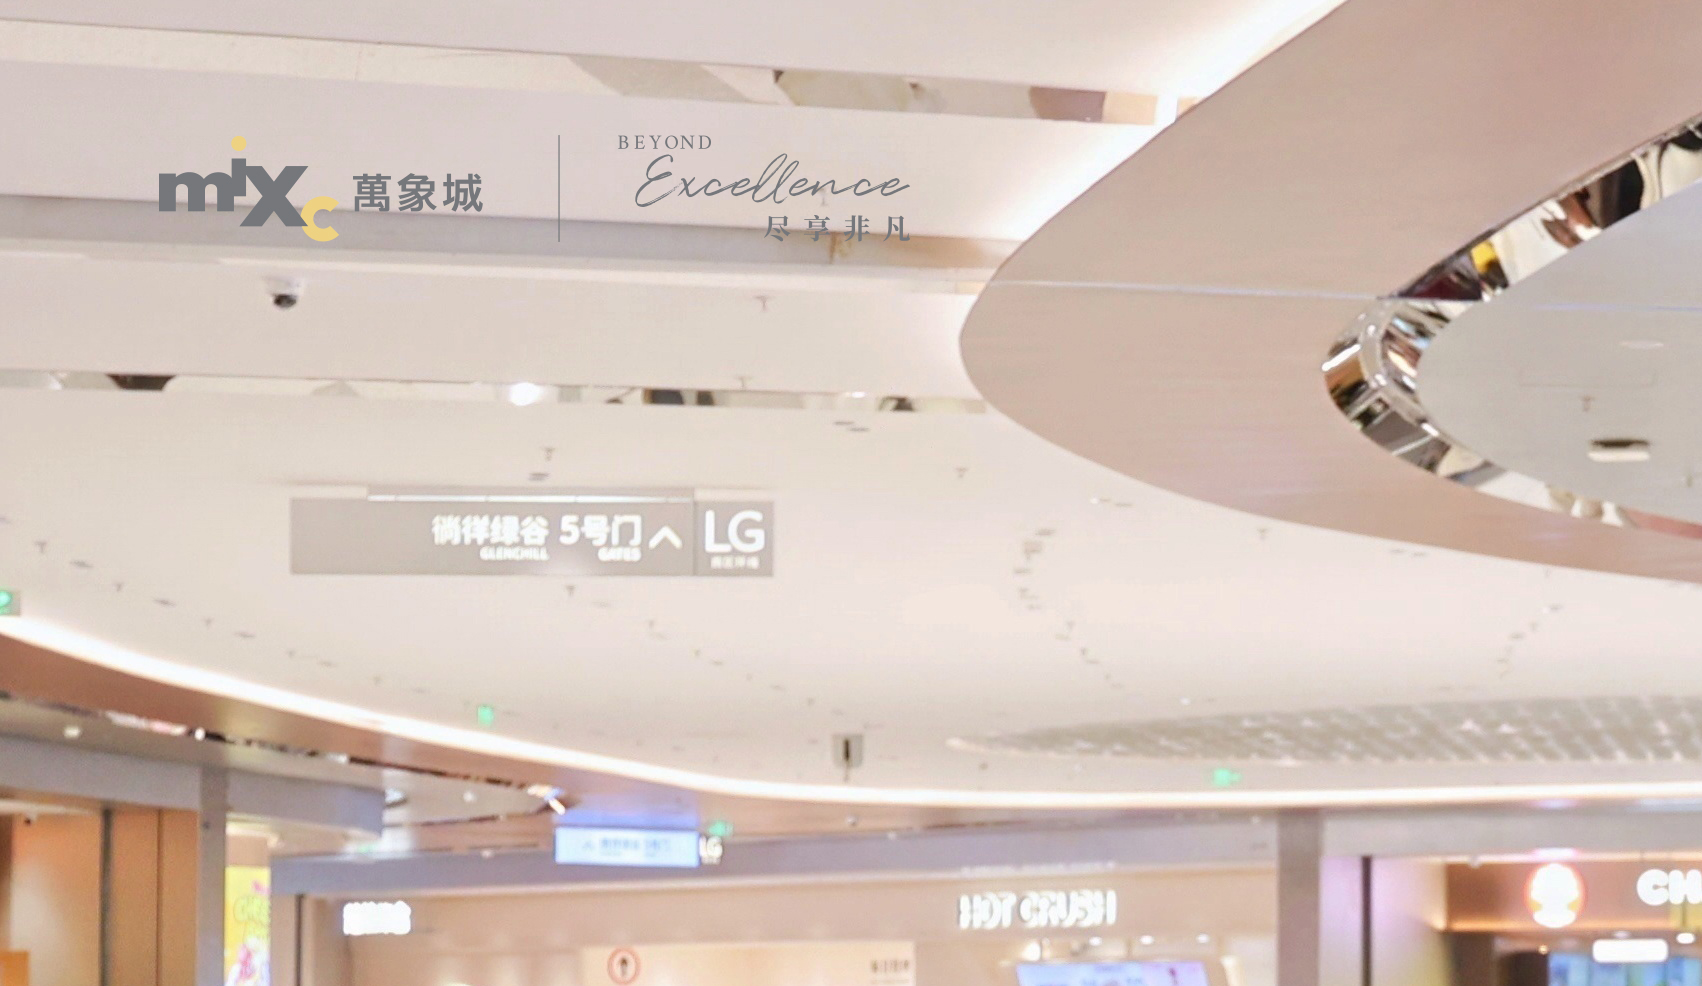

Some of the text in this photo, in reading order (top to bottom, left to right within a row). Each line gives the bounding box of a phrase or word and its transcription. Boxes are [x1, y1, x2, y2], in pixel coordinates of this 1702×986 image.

[558, 514, 643, 547] 5号门
[704, 509, 766, 553] LG
[959, 888, 1118, 930] HOT CRUSH
